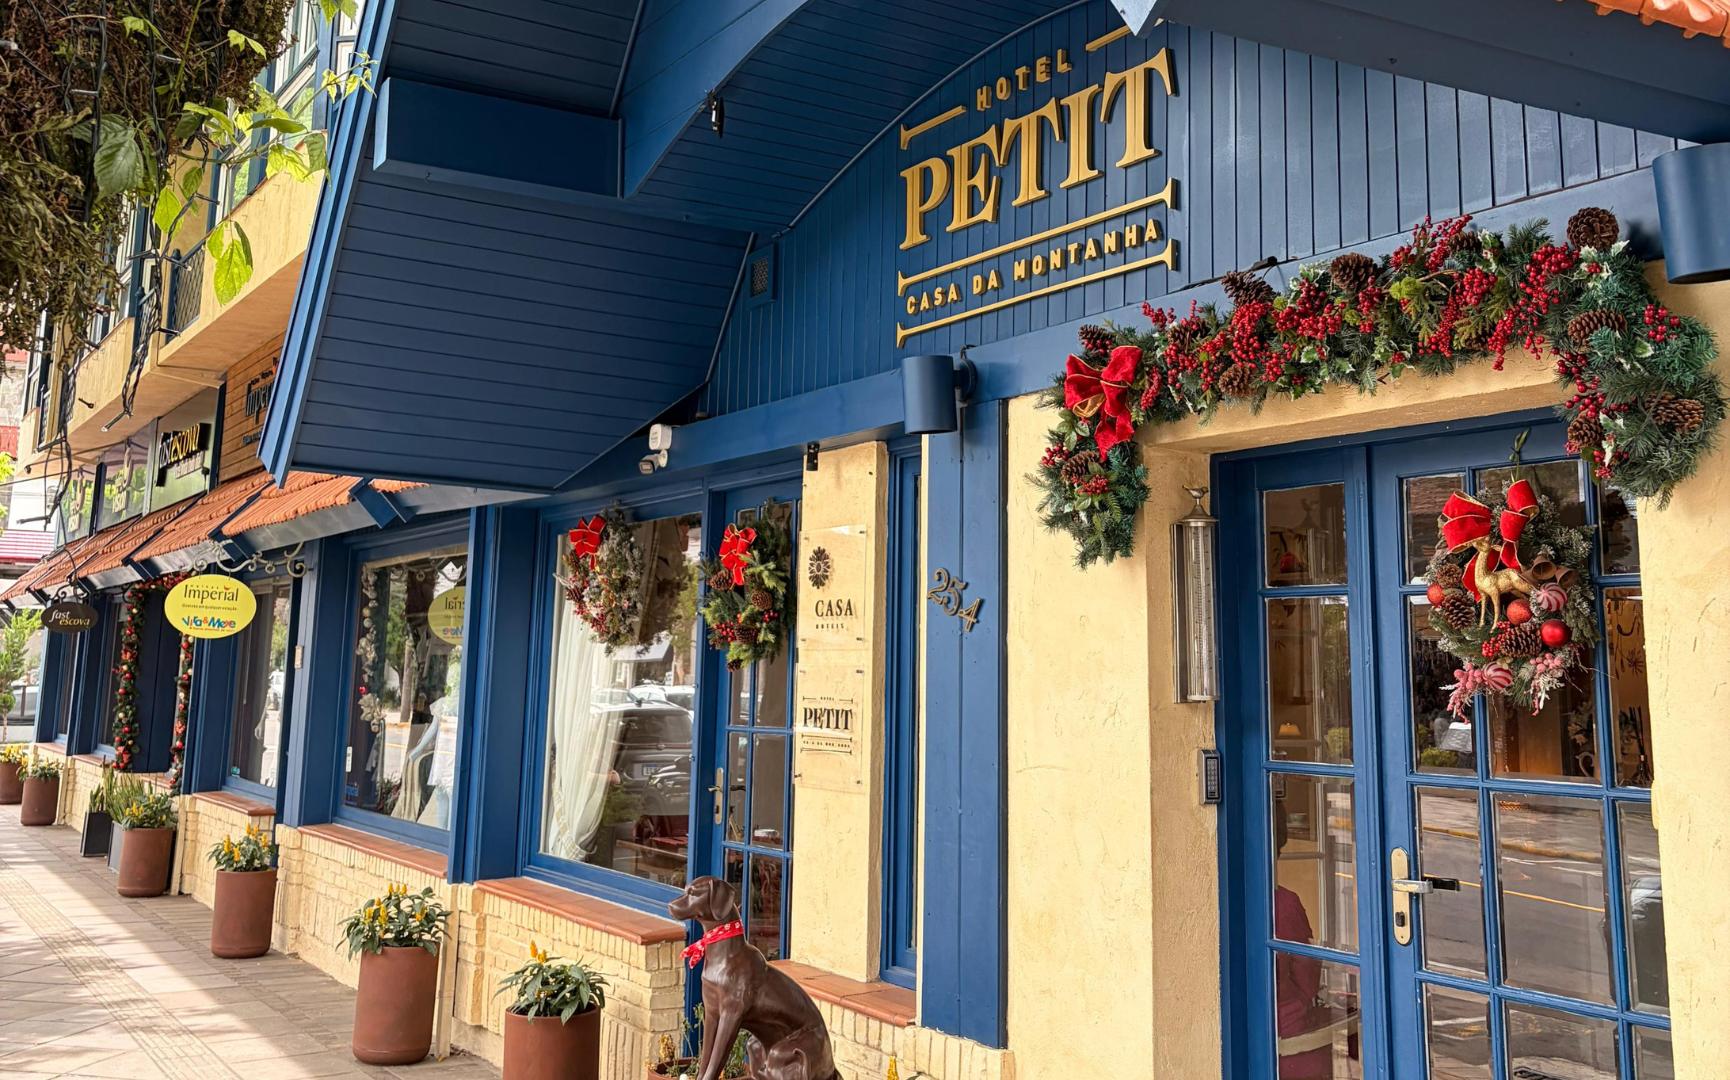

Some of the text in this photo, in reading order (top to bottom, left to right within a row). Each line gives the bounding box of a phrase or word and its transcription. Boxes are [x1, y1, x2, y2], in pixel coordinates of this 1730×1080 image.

[976, 48, 1072, 111] HOTEL
[899, 47, 1177, 250] PETIT
[906, 218, 1162, 315] CASA DA MONTANHA
[184, 582, 239, 604] Imperial
[815, 598, 853, 617] CASA
[927, 567, 983, 633] 254
[48, 609, 71, 623] fast
[802, 707, 853, 730] PETIT
